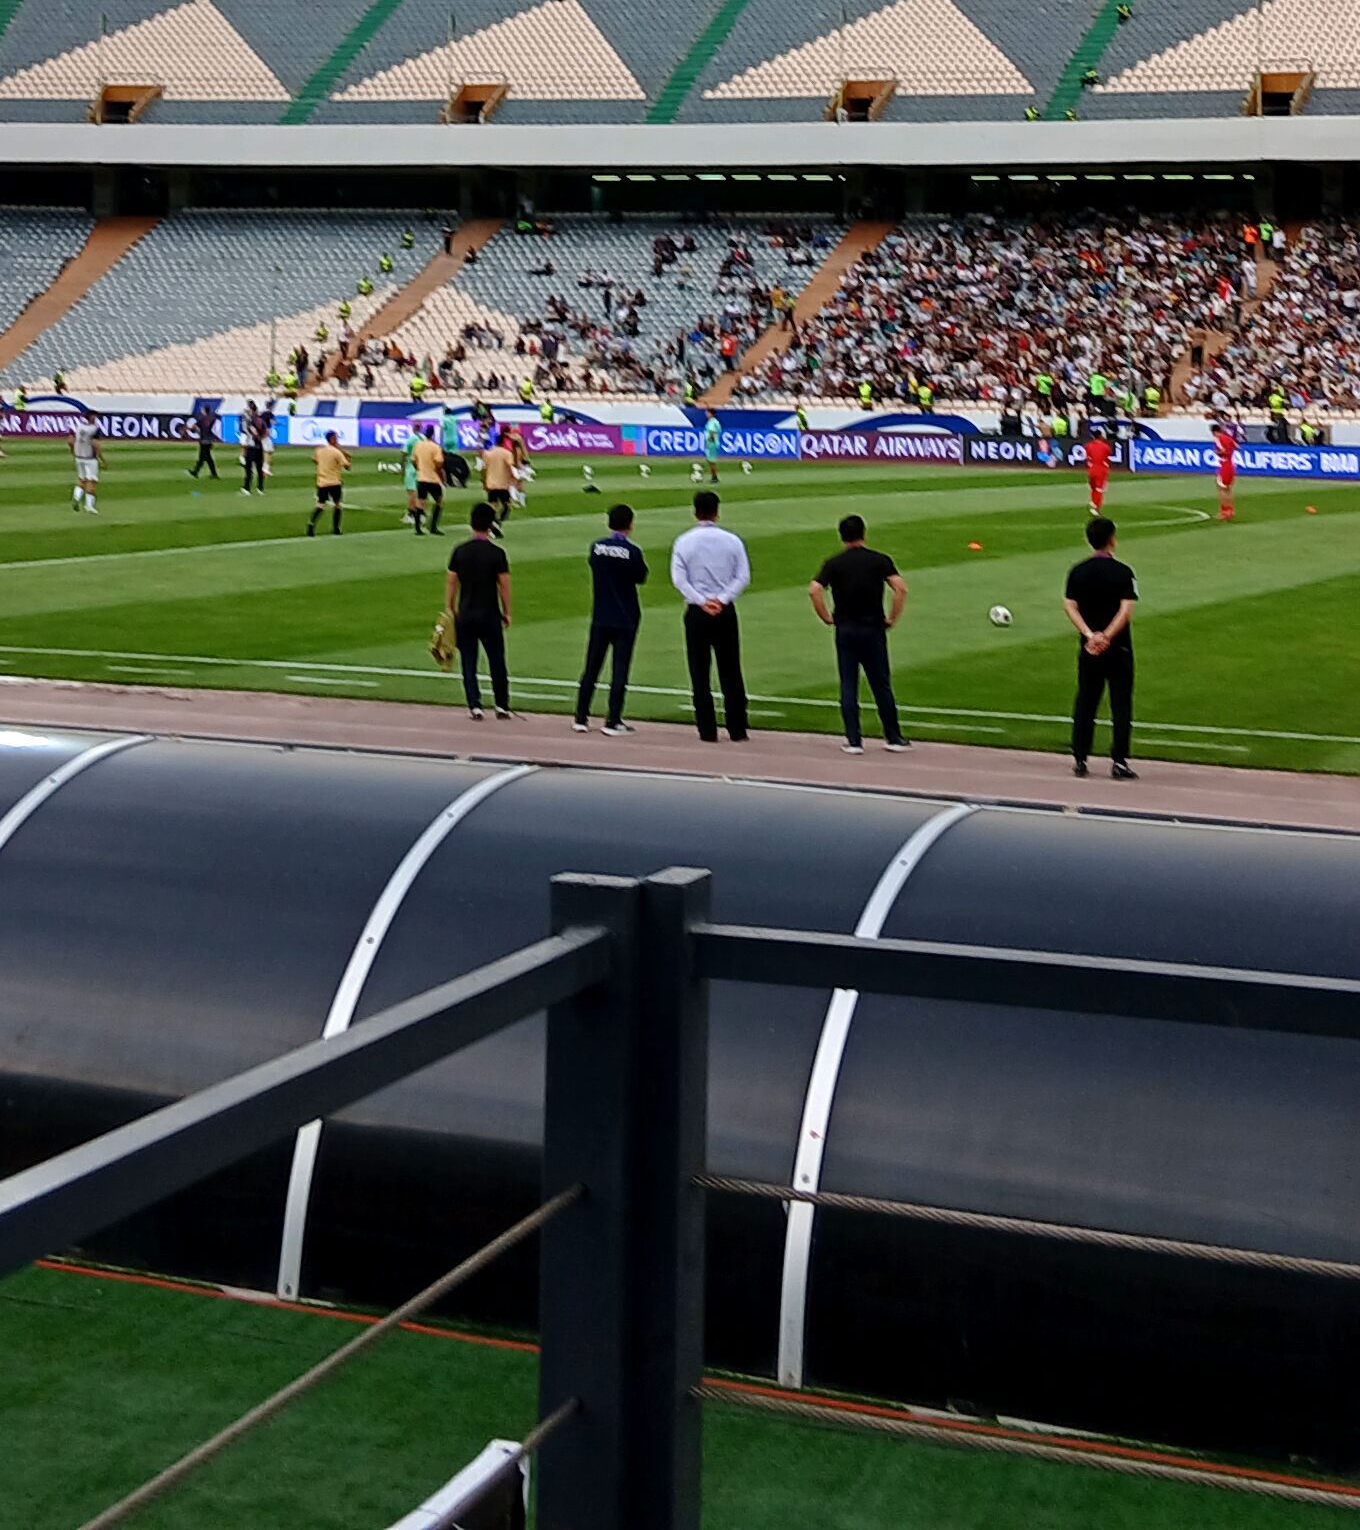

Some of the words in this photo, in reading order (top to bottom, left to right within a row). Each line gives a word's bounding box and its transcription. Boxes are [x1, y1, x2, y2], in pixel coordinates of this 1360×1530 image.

[648, 429, 705, 453] CREDI
[720, 432, 797, 456] SAISON
[800, 433, 868, 459] QATAR
[874, 434, 962, 459] AIRWAYS
[969, 440, 1033, 461] NEOM
[1143, 446, 1201, 467] ASIAN
[1202, 448, 1313, 471] QALIFIERS
